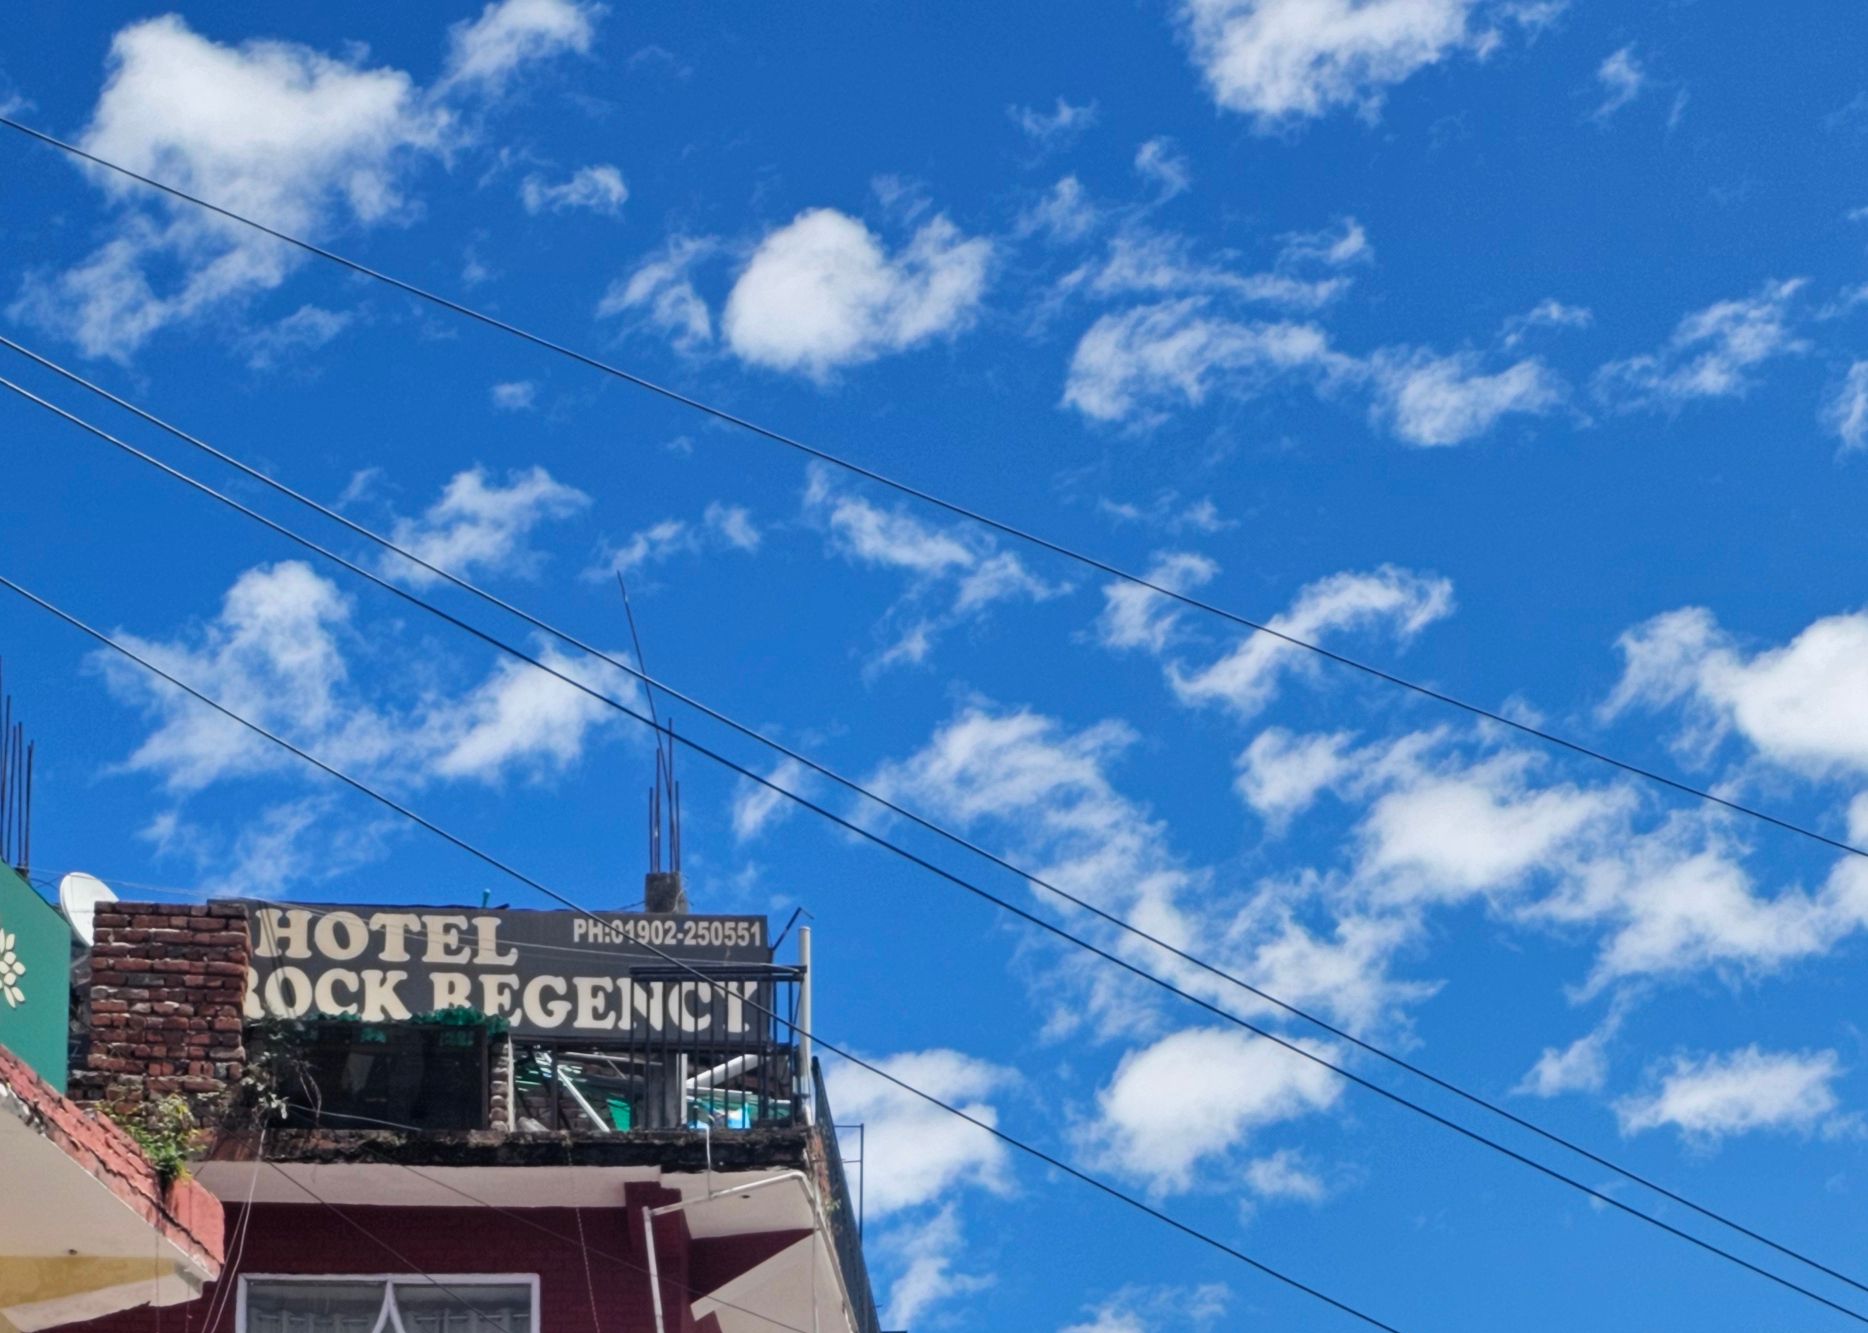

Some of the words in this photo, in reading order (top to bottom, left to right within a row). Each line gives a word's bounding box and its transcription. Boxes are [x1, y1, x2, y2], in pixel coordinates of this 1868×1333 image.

[255, 908, 518, 966] HOTEL
[573, 918, 761, 947] PH:01902-250551
[429, 971, 758, 1033] REGENCY
